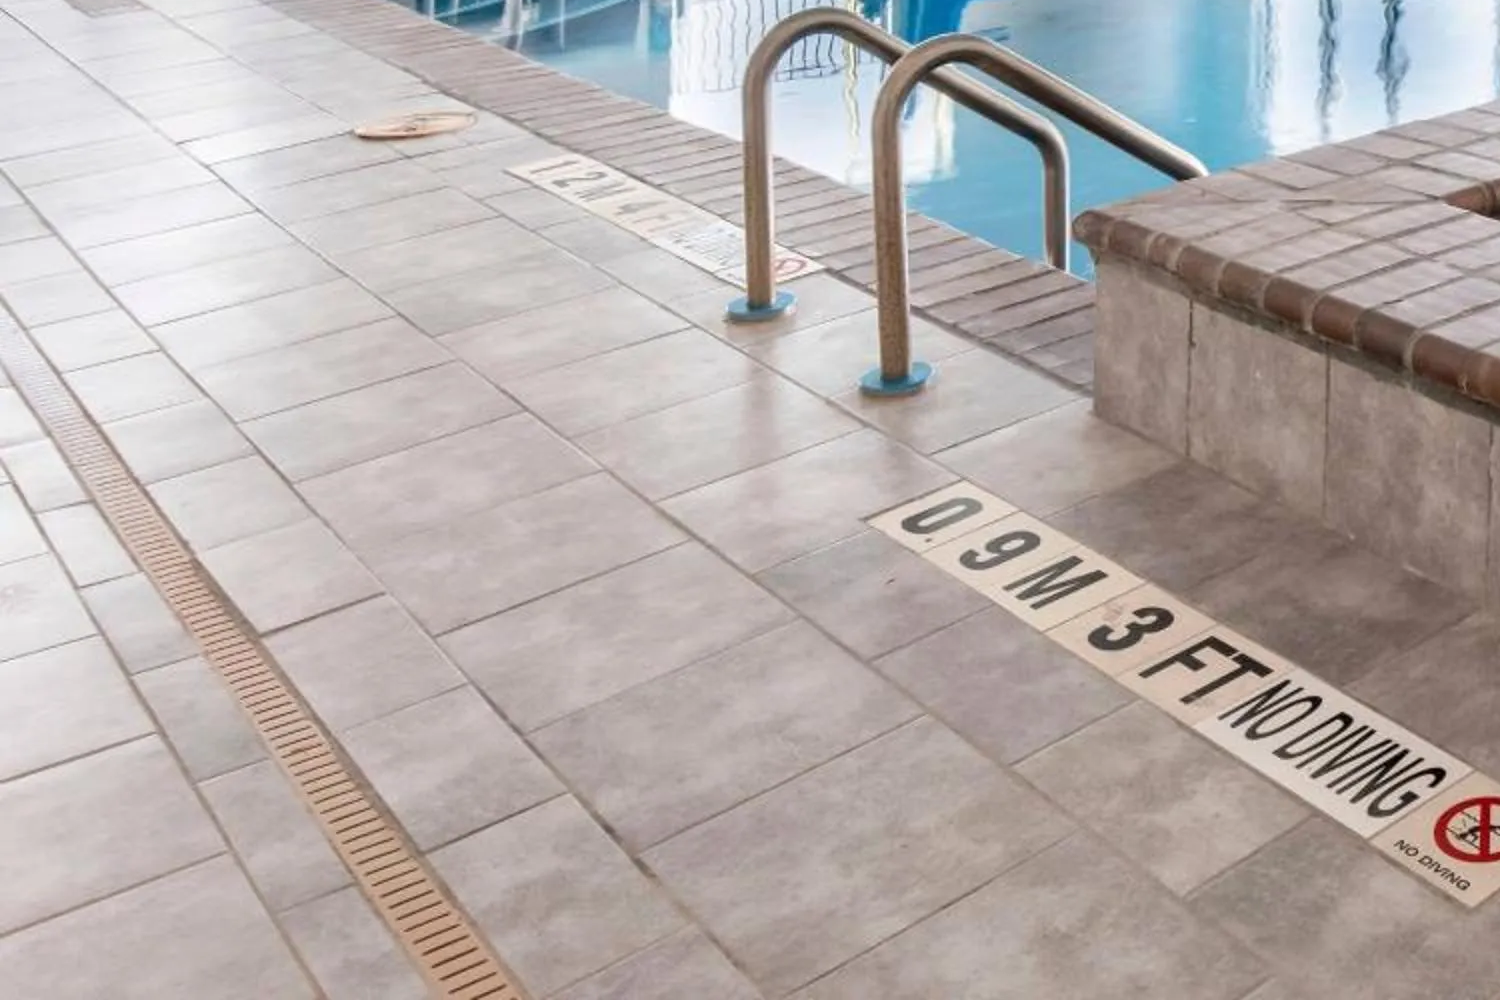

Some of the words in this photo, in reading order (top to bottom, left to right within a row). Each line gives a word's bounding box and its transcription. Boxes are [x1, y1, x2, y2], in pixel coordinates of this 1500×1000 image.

[1087, 606, 1175, 651] 3
[1138, 635, 1275, 705] FT
[1217, 679, 1323, 740] NO
[1272, 711, 1447, 818] DIVING
[1393, 839, 1419, 857] NO
[1418, 855, 1471, 891] DIVING
